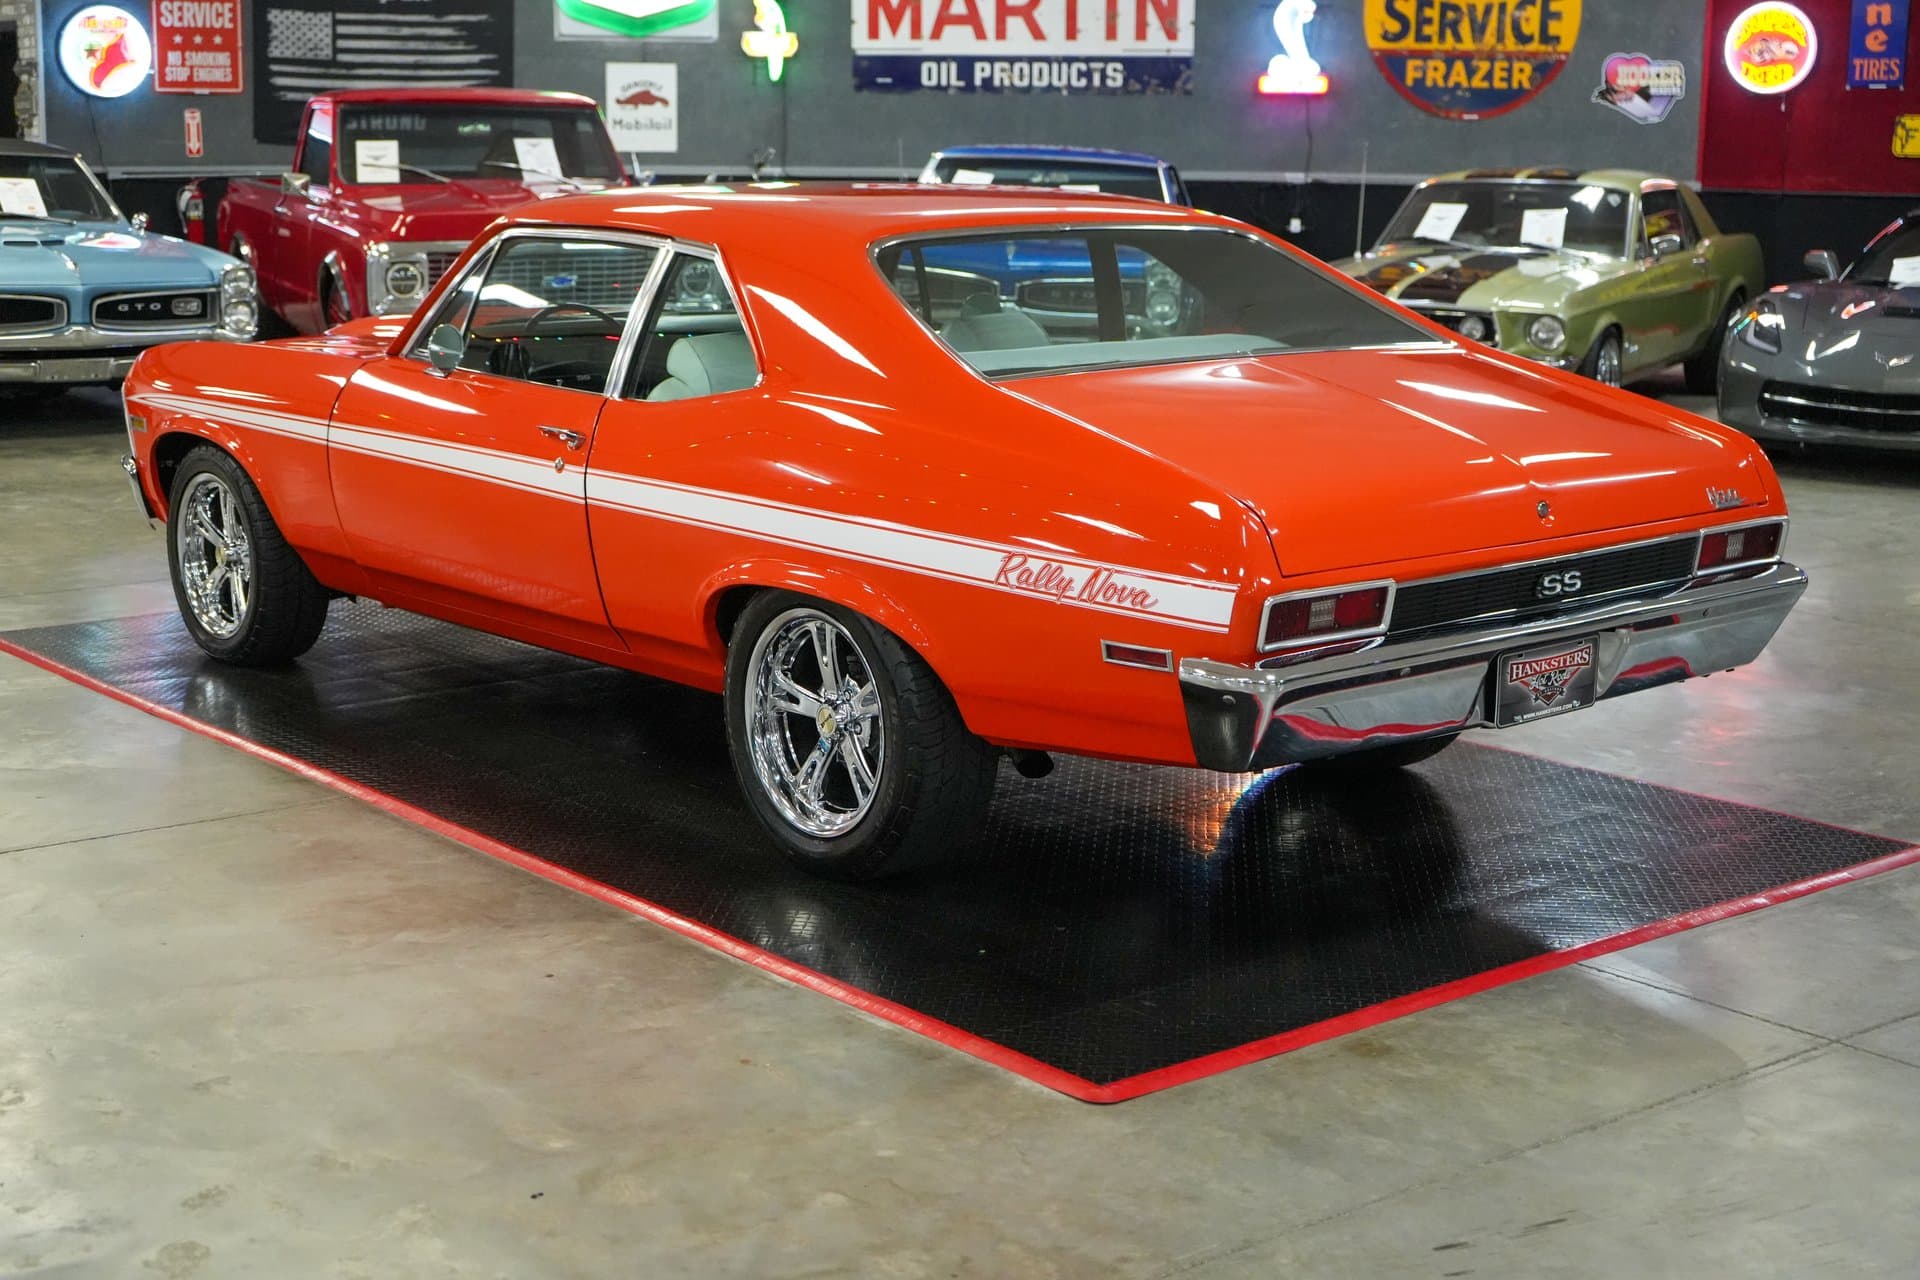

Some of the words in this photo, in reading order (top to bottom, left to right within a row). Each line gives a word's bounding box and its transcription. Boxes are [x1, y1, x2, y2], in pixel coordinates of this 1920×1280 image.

[160, 1, 233, 29] SERVICE
[1381, 0, 1563, 46] SERVICE
[167, 51, 182, 66] NO
[185, 51, 231, 66] SMOKING
[1852, 58, 1901, 82] TIRES
[165, 66, 190, 82] STOP
[193, 67, 232, 82] ENGINES
[920, 61, 966, 88] OIL
[973, 61, 1124, 88] PRODUCTS
[1405, 59, 1534, 89] FRAZER
[117, 302, 162, 312] GTO
[994, 551, 1075, 604] Rally
[1076, 566, 1159, 609] Nova
[1538, 570, 1582, 597] SS
[1511, 648, 1591, 680] HANKSTERS
